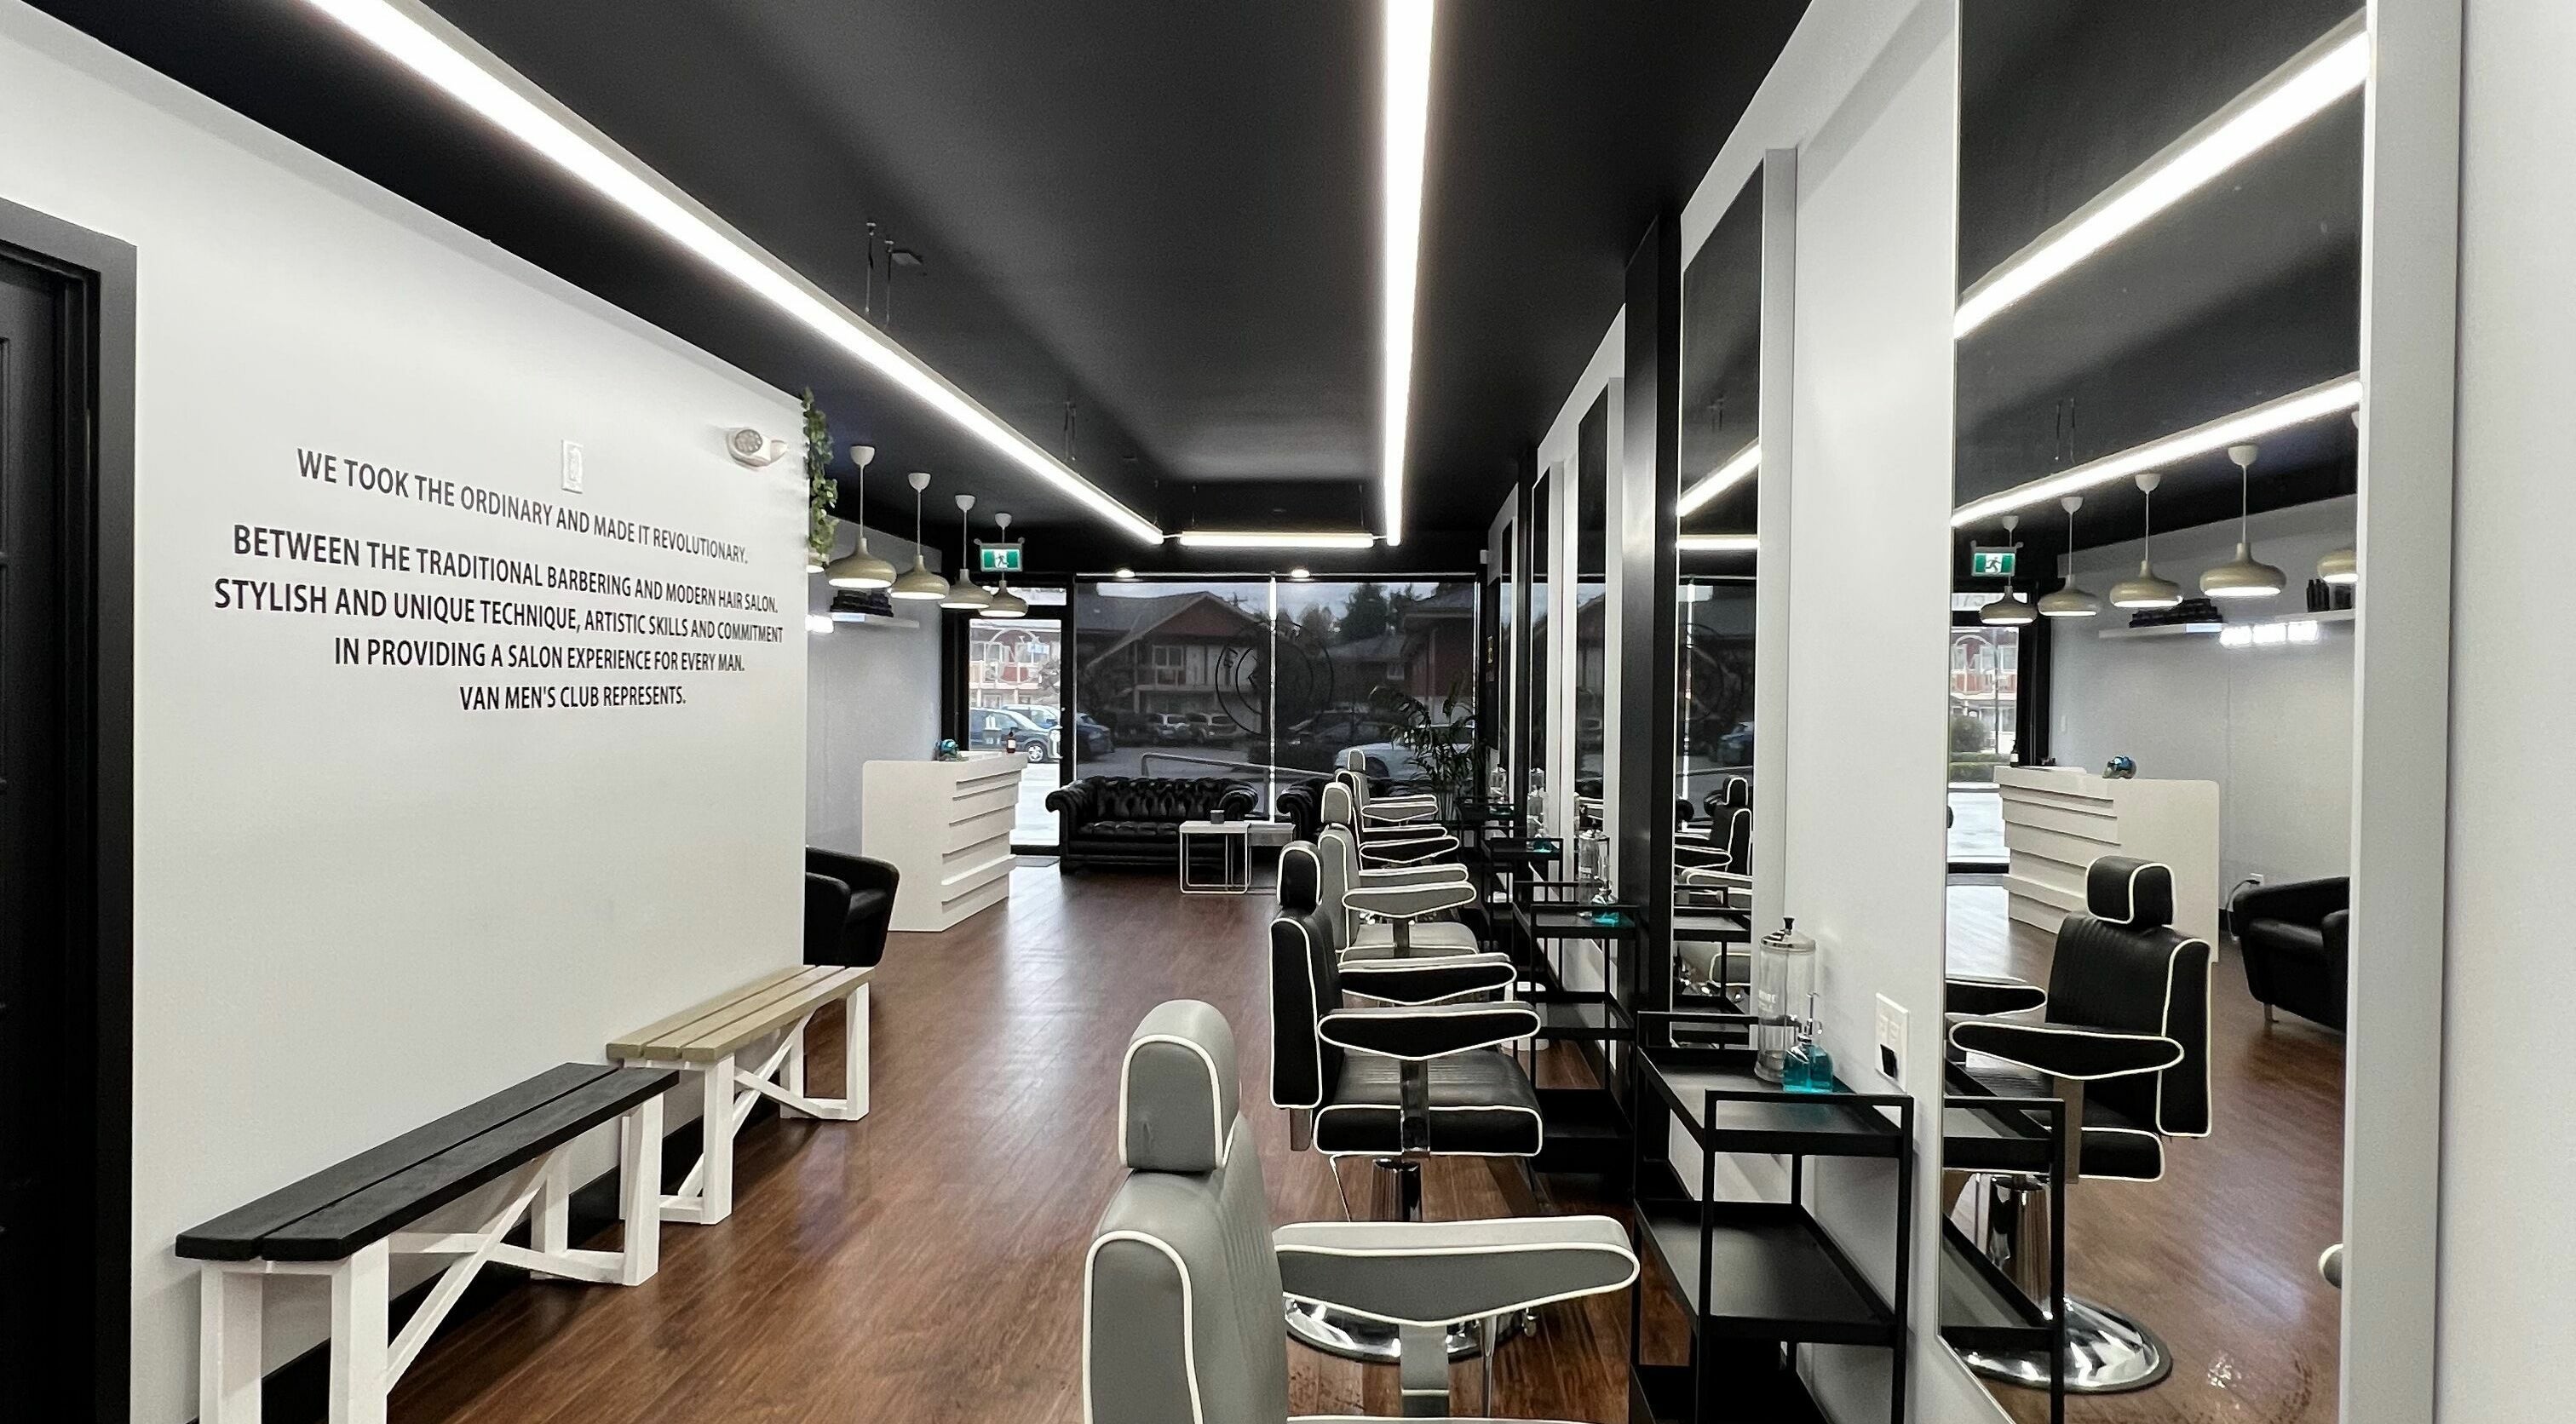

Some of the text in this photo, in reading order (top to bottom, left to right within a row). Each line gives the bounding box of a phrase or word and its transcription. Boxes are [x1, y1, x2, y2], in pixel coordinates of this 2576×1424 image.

[296, 448, 748, 564] WE TOOK THE ORDINARY AND MADE IT REVOLUTIONARY.
[233, 524, 779, 614] BETWEEN THE TRADITIONAL BARBERING AND MODERN HAIR SALON.
[215, 577, 784, 643] STYLISH AND UNIQUE TECHNIQUE, ARTISTIC SKILLS AND COMMITMENT
[335, 637, 745, 672] IN PROVIDING A SALON EXPERIENCE FOR EVERY MAN.
[459, 686, 687, 711] VAN MEN'S CLUB REPRESENTS.
